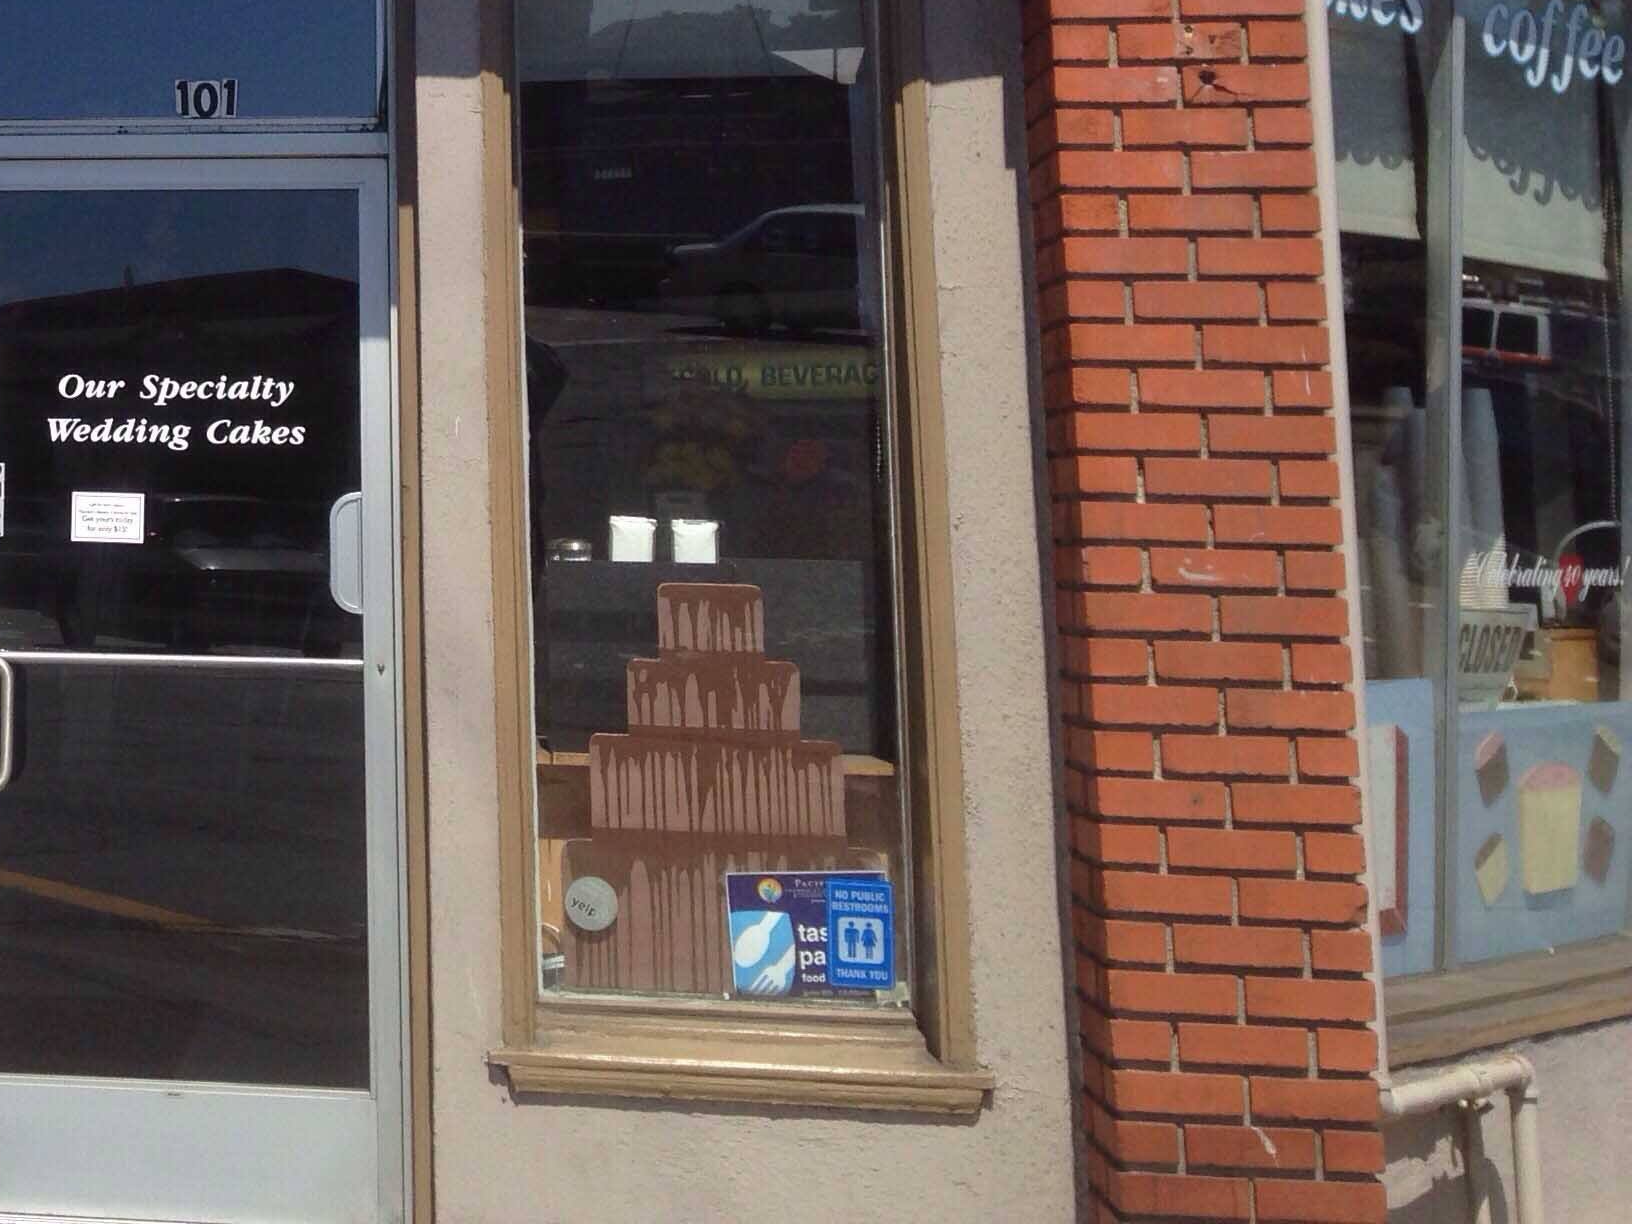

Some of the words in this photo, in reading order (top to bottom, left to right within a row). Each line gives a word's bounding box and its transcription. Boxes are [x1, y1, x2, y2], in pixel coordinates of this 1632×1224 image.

[176, 80, 237, 118] 101
[58, 375, 126, 399] Our
[140, 375, 294, 407] Specialty
[47, 418, 191, 451] Wedding
[206, 419, 306, 445] Cakes
[1458, 624, 1522, 673] CLOSED
[835, 890, 848, 900] NO
[851, 891, 885, 902] PUBLIC
[571, 897, 597, 916] yelp
[832, 902, 889, 913] RESTROOMS
[801, 973, 826, 983] food
[837, 968, 867, 979] THANK
[869, 970, 889, 980] YOU
